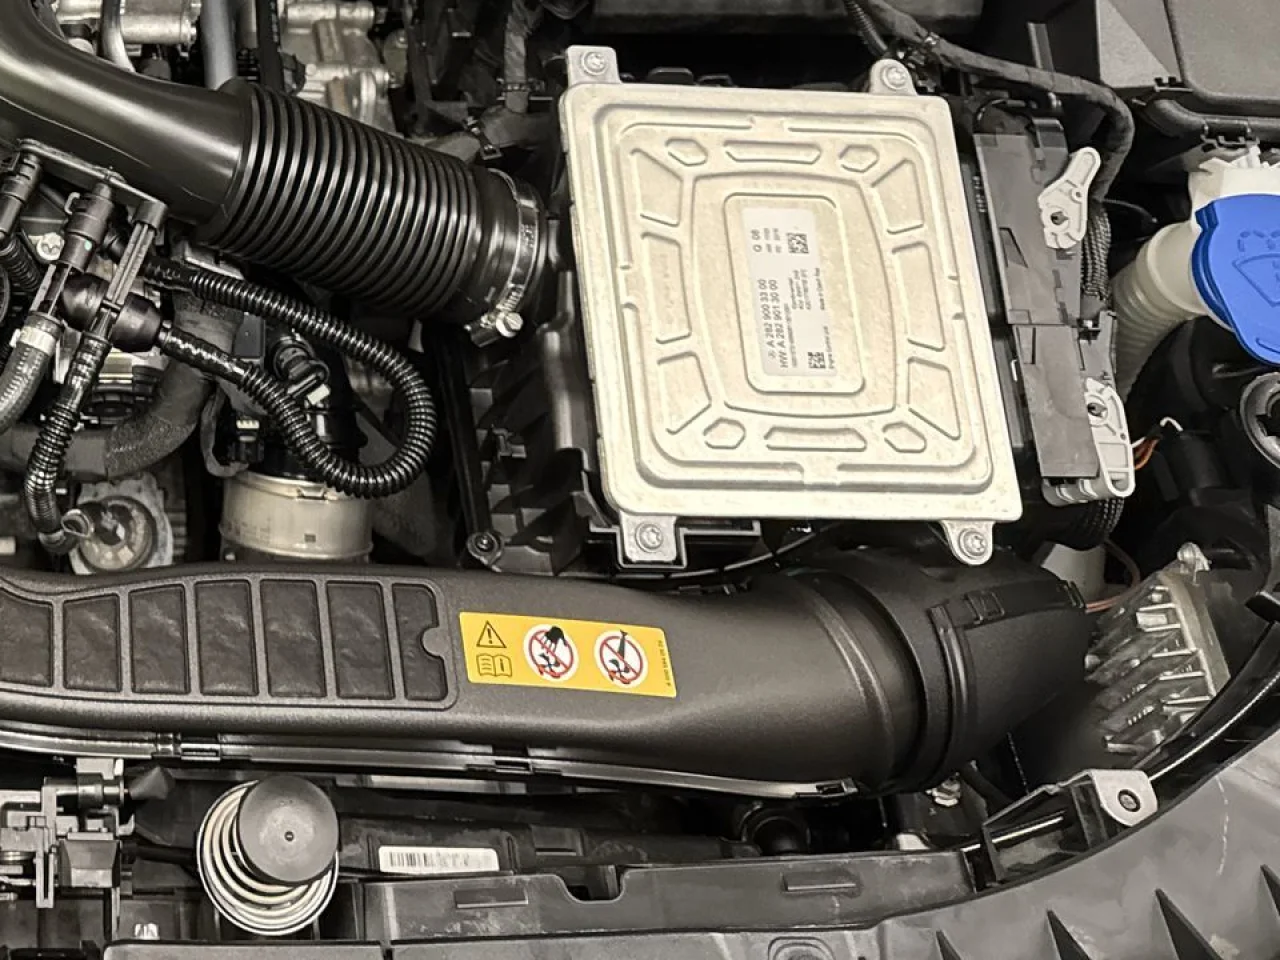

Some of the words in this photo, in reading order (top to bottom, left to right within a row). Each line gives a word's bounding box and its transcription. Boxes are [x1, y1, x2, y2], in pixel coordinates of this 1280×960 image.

[757, 278, 768, 290] 00
[761, 304, 771, 321] 900
[763, 322, 773, 339] 282
[774, 323, 784, 339] 282
[778, 351, 788, 368] HW
